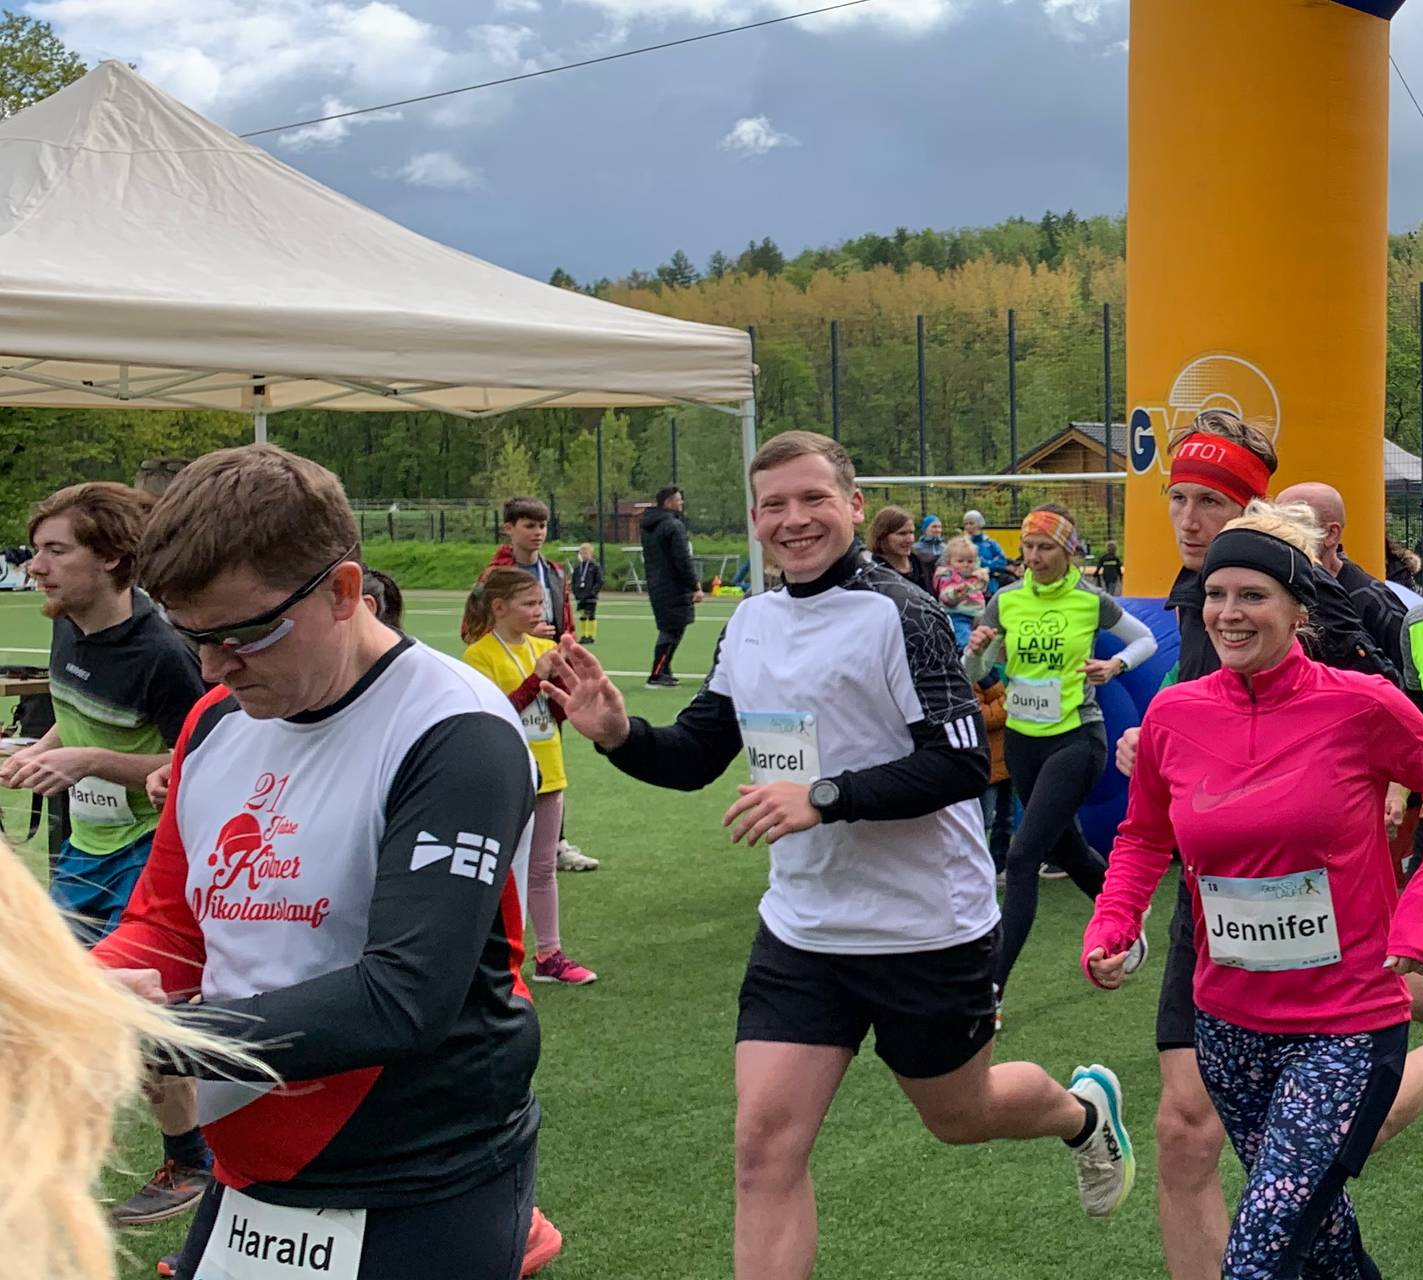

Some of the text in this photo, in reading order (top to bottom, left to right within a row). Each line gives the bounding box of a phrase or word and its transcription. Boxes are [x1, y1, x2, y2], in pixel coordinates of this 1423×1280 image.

[1017, 637, 1065, 651] LAUF
[1017, 652, 1064, 665] TEAM
[1012, 693, 1049, 711] Dunja
[748, 746, 804, 771] Marcel
[244, 772, 290, 813] 21
[1211, 913, 1329, 942] Jennifer
[1102, 1120, 1122, 1162] HOKA
[227, 1214, 335, 1272] Harald
